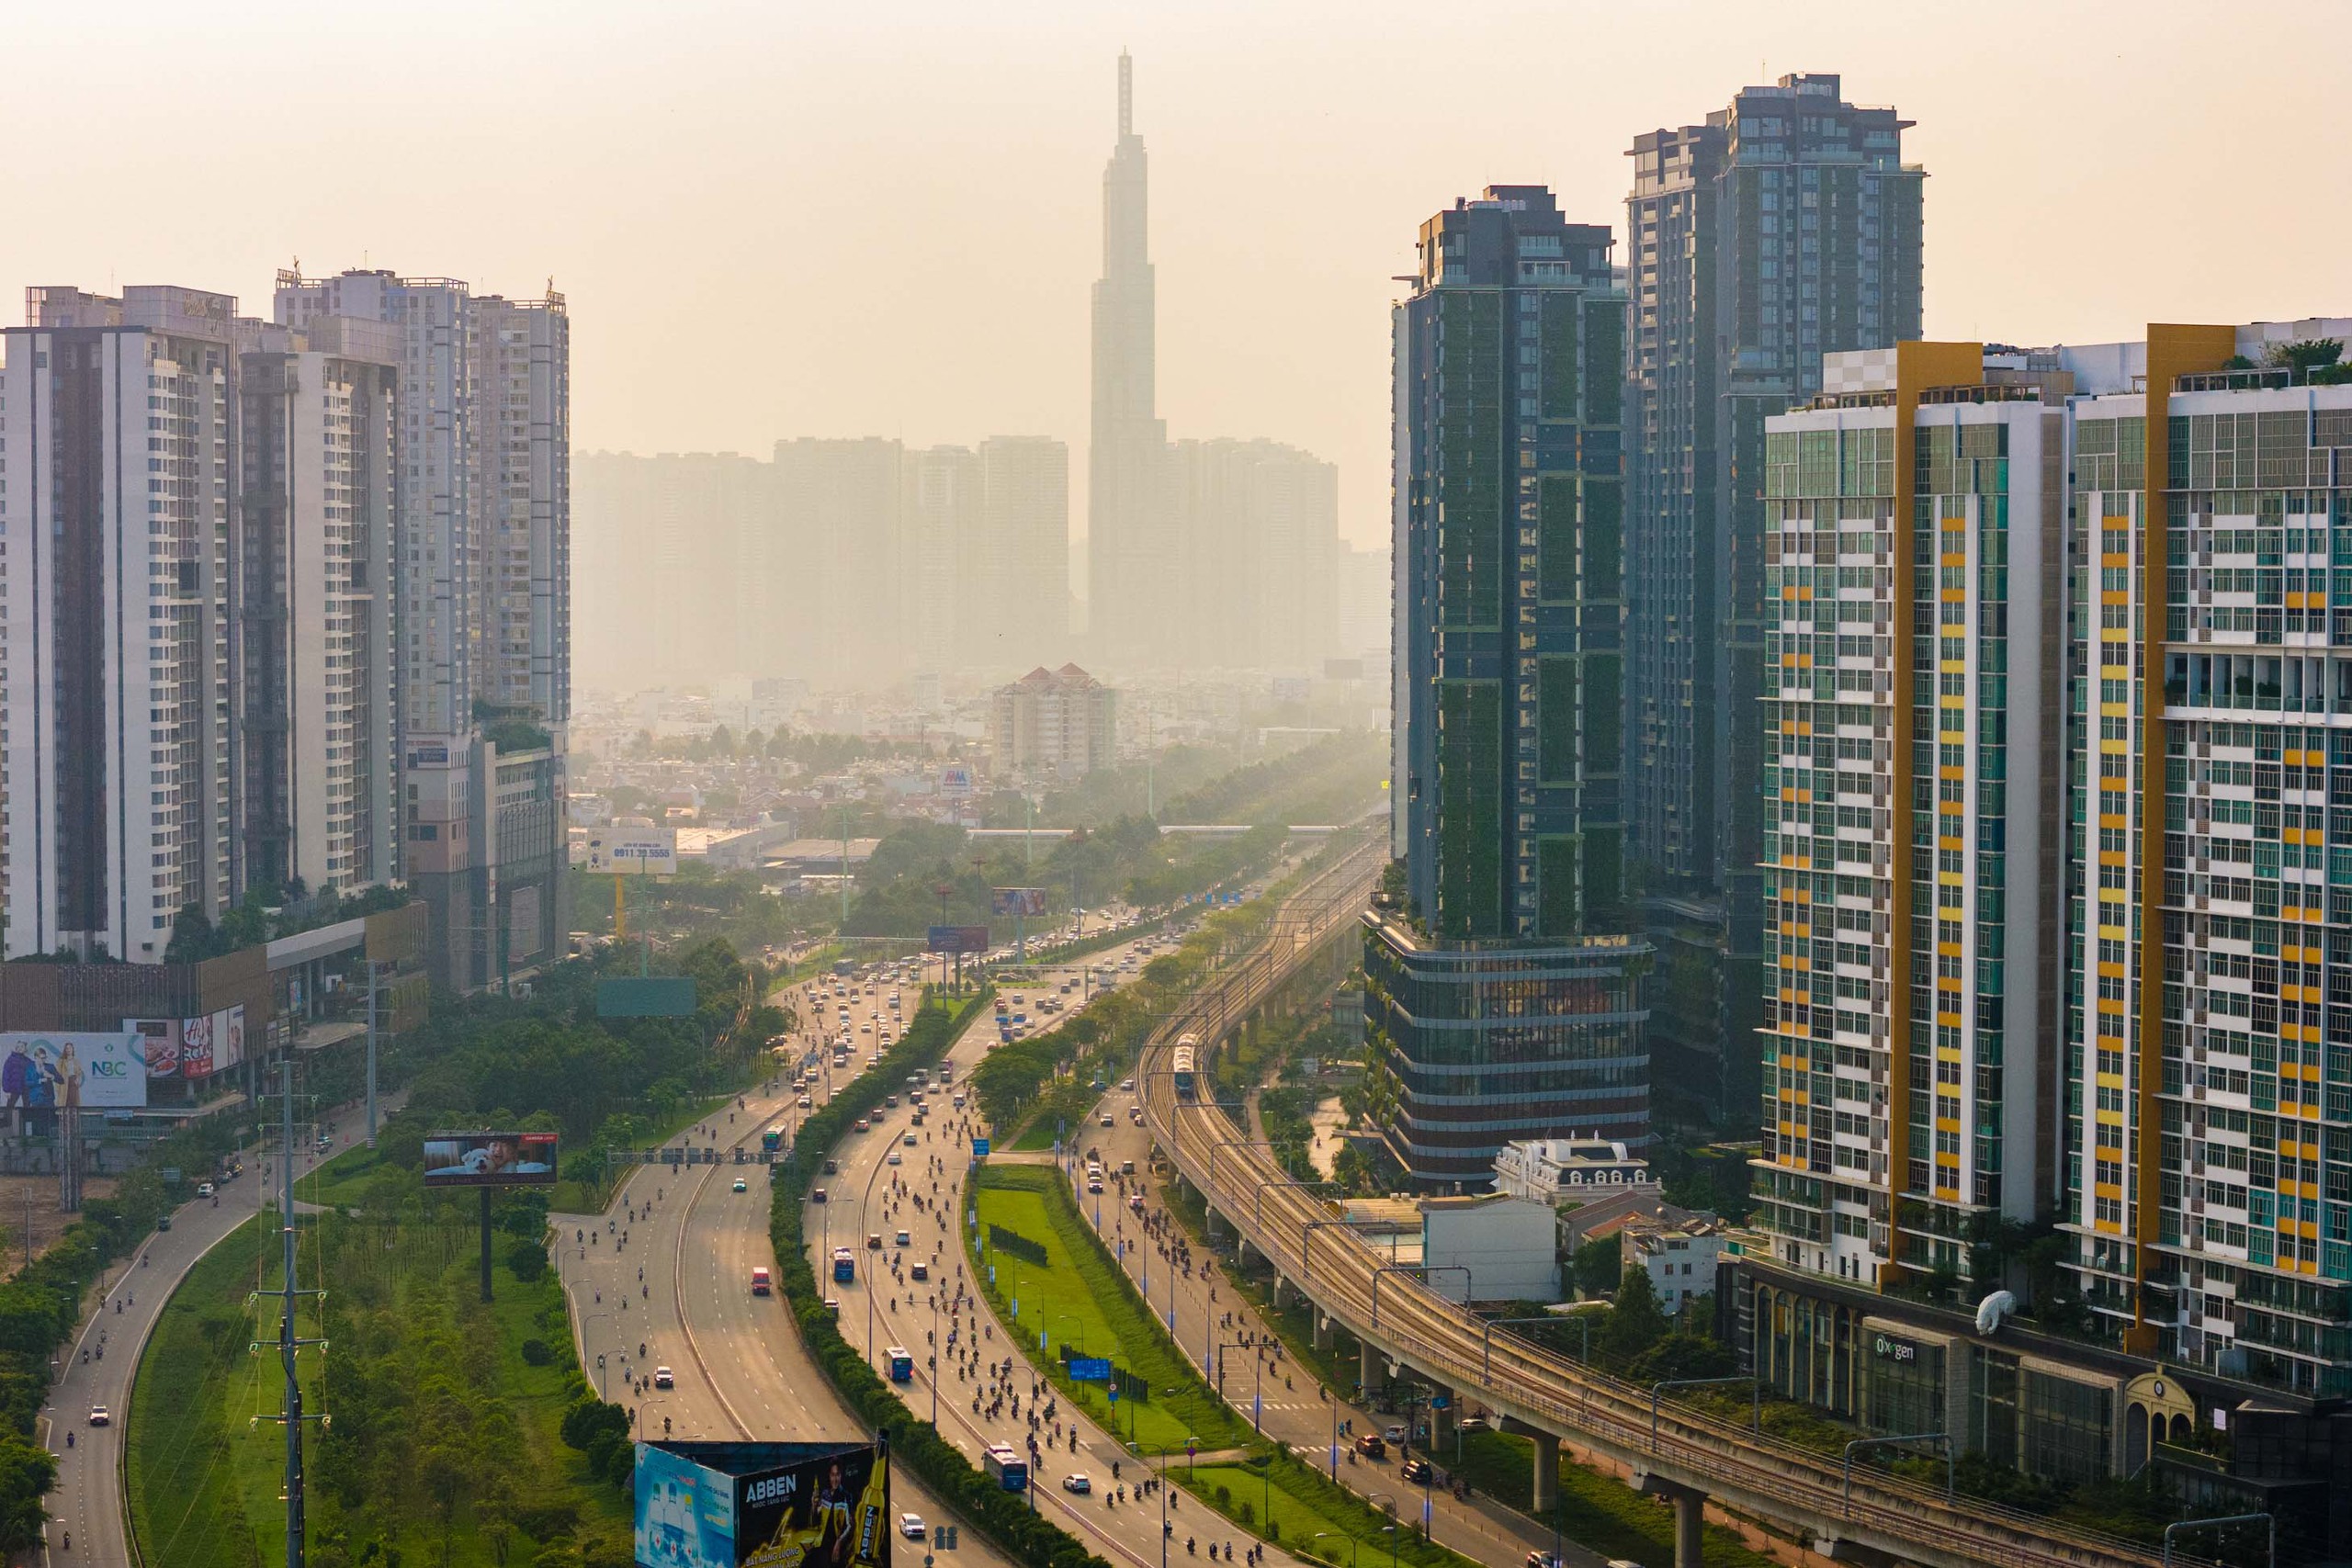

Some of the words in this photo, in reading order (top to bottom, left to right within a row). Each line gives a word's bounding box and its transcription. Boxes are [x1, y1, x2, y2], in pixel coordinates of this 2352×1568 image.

[92, 1061, 127, 1077] NBC
[745, 1473, 797, 1504] ABBEN
[860, 1506, 875, 1560] ABBEN
